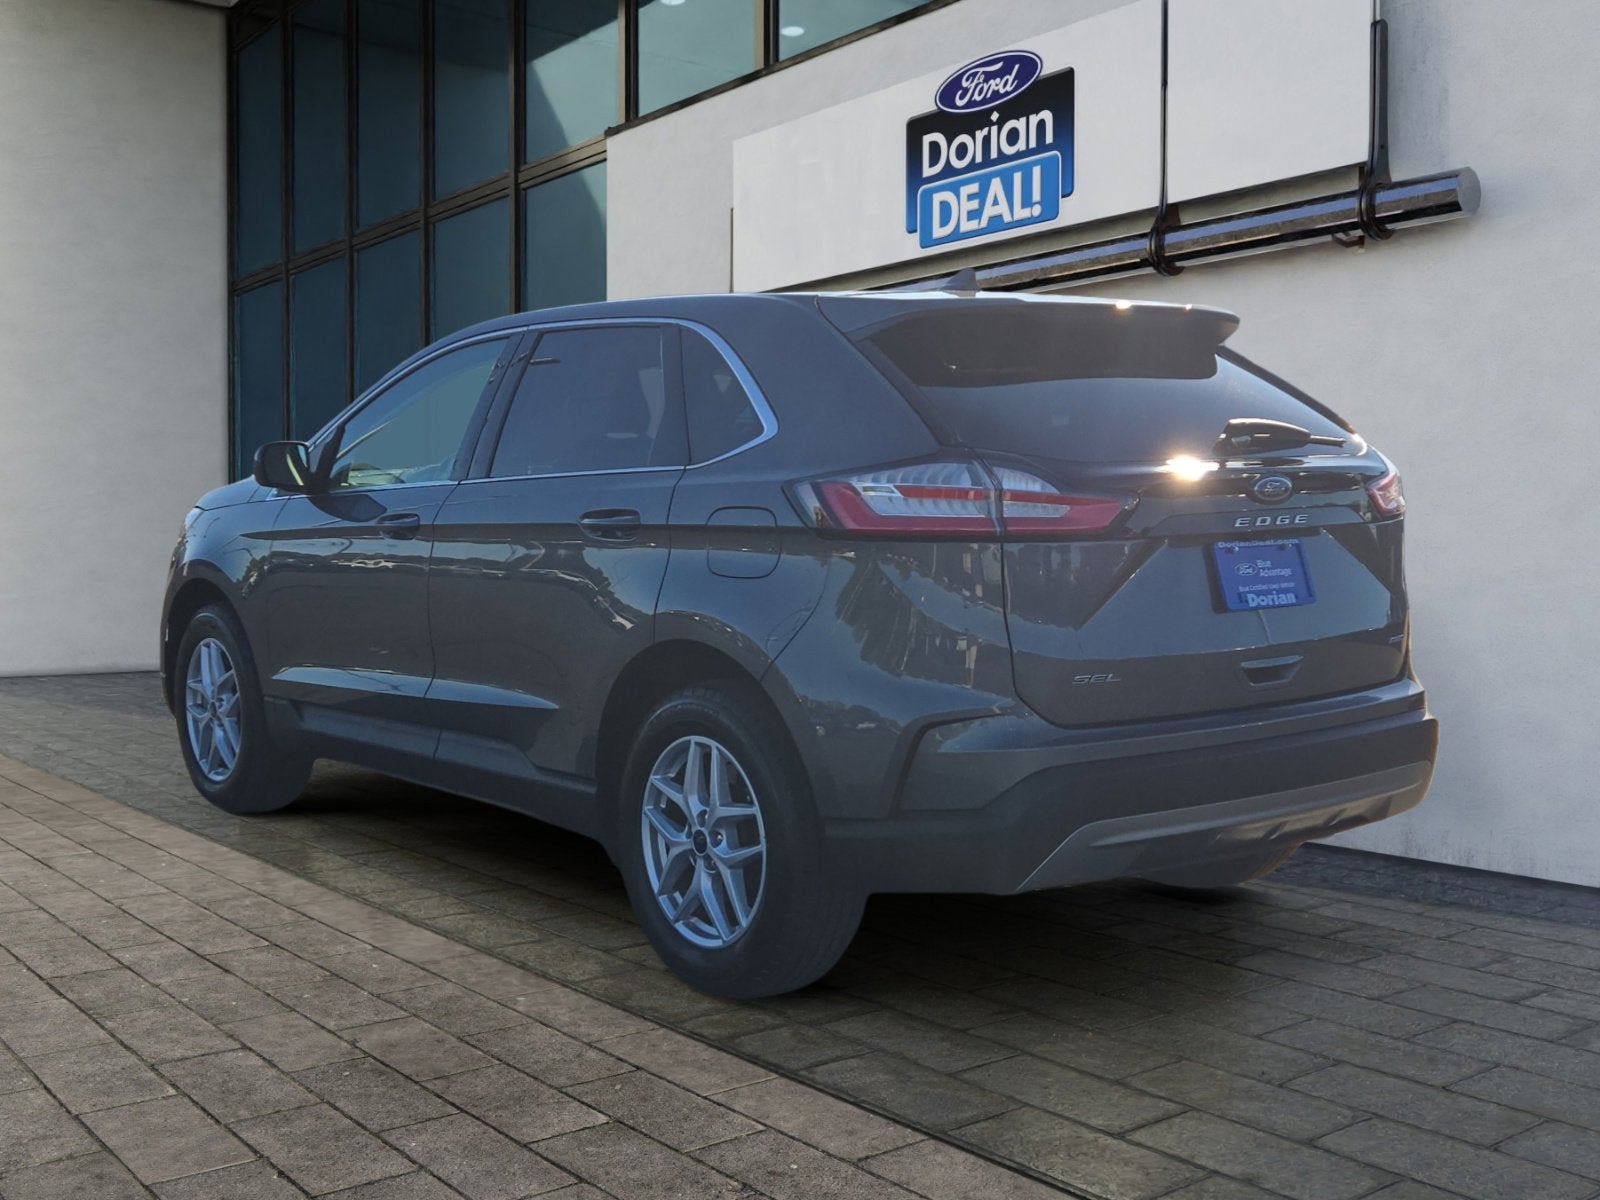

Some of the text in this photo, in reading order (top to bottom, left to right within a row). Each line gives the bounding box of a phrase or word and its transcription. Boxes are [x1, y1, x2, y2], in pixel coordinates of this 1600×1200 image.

[955, 61, 1020, 107] Ford
[922, 109, 1054, 178] Dorian
[932, 165, 1042, 240] DEAL!
[1234, 514, 1309, 527] EDGE
[1247, 591, 1297, 607] Dorian
[1072, 674, 1121, 685] SEL
